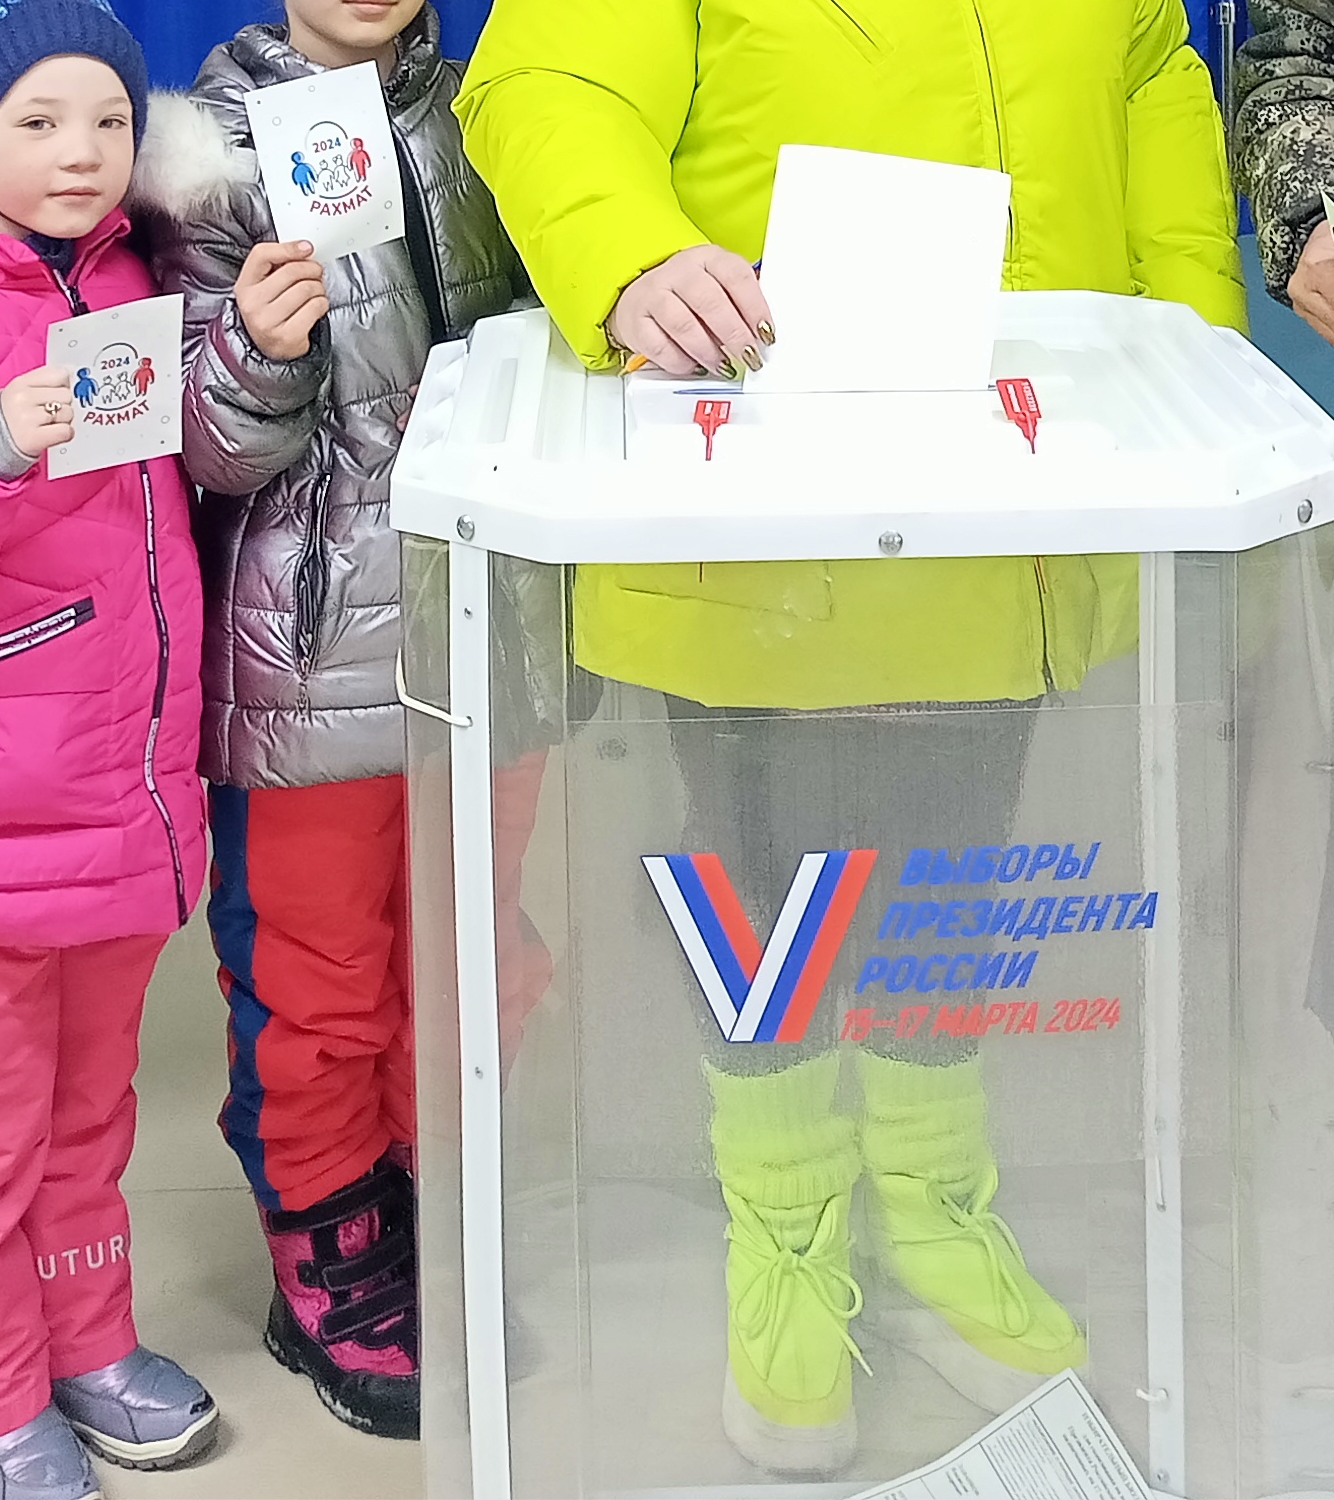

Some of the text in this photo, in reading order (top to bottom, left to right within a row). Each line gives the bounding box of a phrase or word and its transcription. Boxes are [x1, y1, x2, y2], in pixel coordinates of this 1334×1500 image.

[312, 137, 342, 154] 2024
[100, 356, 130, 371] 2024
[899, 841, 1102, 887] ВЫБОРЫ
[876, 891, 1159, 942] ПРЕЗИДЕНТА
[855, 950, 1039, 995] РОССИИ
[931, 1002, 1040, 1039] МАРТА
[1043, 997, 1122, 1033] 2024
